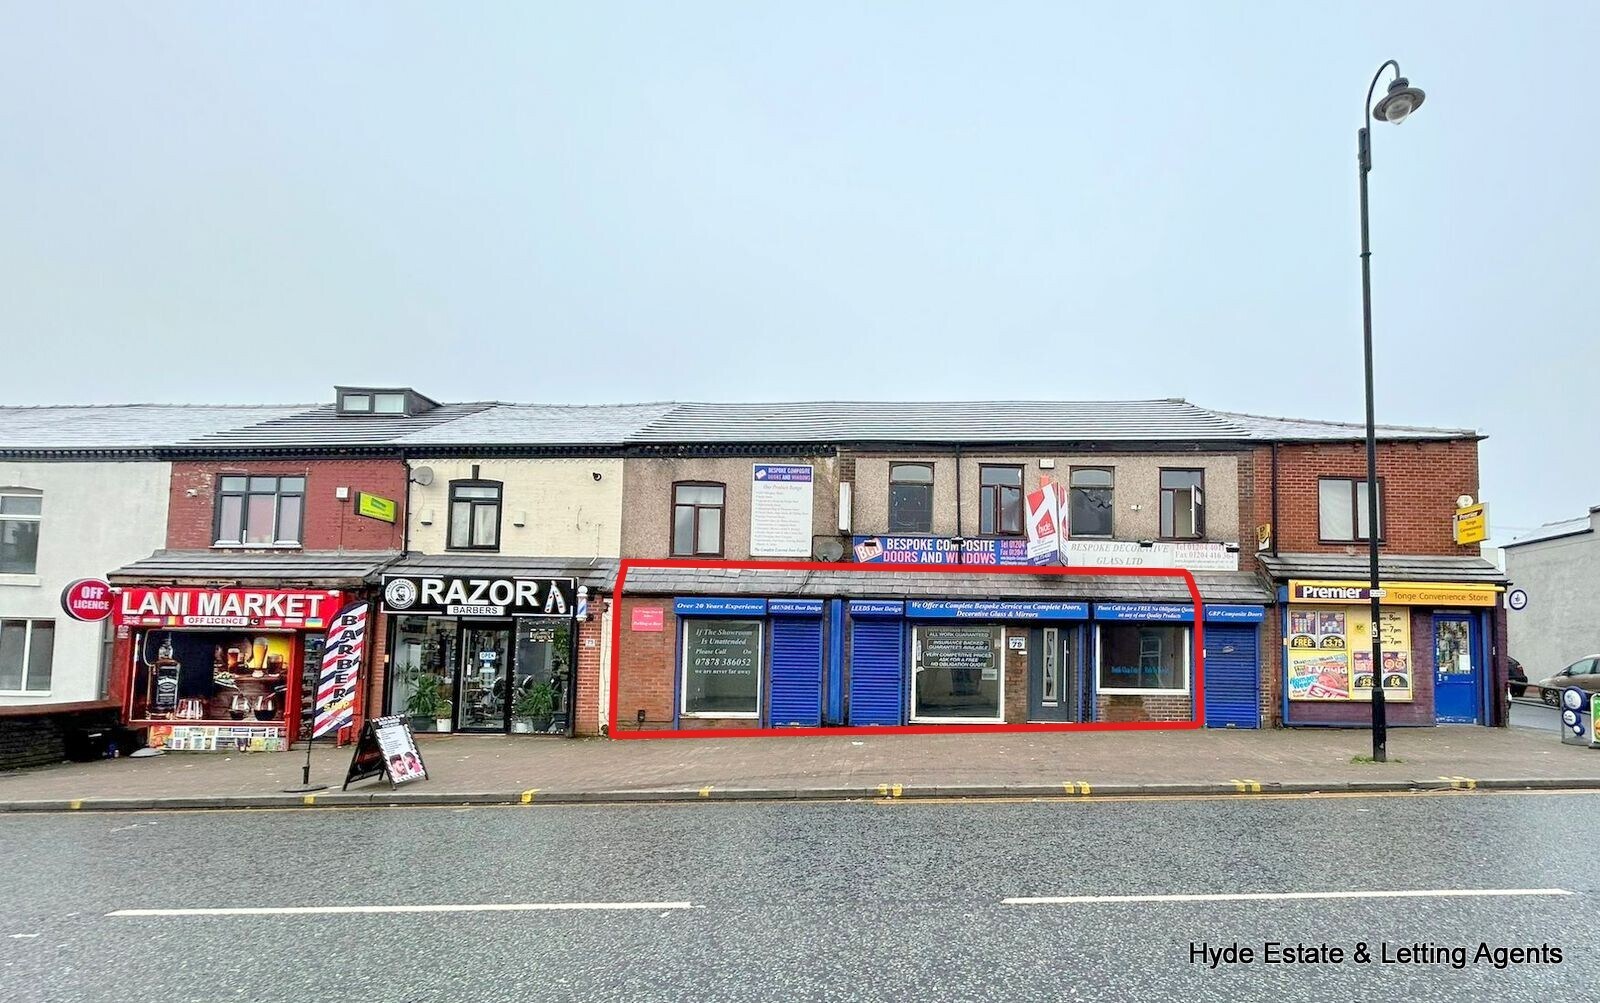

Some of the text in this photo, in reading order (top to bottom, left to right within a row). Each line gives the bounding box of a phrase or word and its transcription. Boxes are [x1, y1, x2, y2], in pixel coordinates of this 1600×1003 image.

[887, 538, 934, 551] BESPOKE
[1071, 544, 1113, 552] BESPOKE
[883, 551, 918, 563] DOORS
[921, 552, 942, 564] AND
[1096, 557, 1126, 565] GLASS
[80, 586, 104, 598] OFF
[420, 578, 540, 606] RAZOR
[1302, 586, 1362, 598] Premier
[1394, 592, 1417, 601] Tonge
[1419, 592, 1466, 600] Convenience
[74, 599, 110, 610] LICENCE
[121, 591, 324, 618] LANI MARKET
[922, 602, 939, 610] Offer
[945, 602, 973, 611] Complete
[974, 603, 1000, 611] Bespoke
[452, 606, 498, 614] BARBERS
[188, 617, 245, 626] OFF LICENCE
[1294, 638, 1313, 647] FREE
[1323, 639, 1344, 648] £3.75
[333, 615, 358, 698] BARBER
[695, 658, 751, 666] 07878 386052
